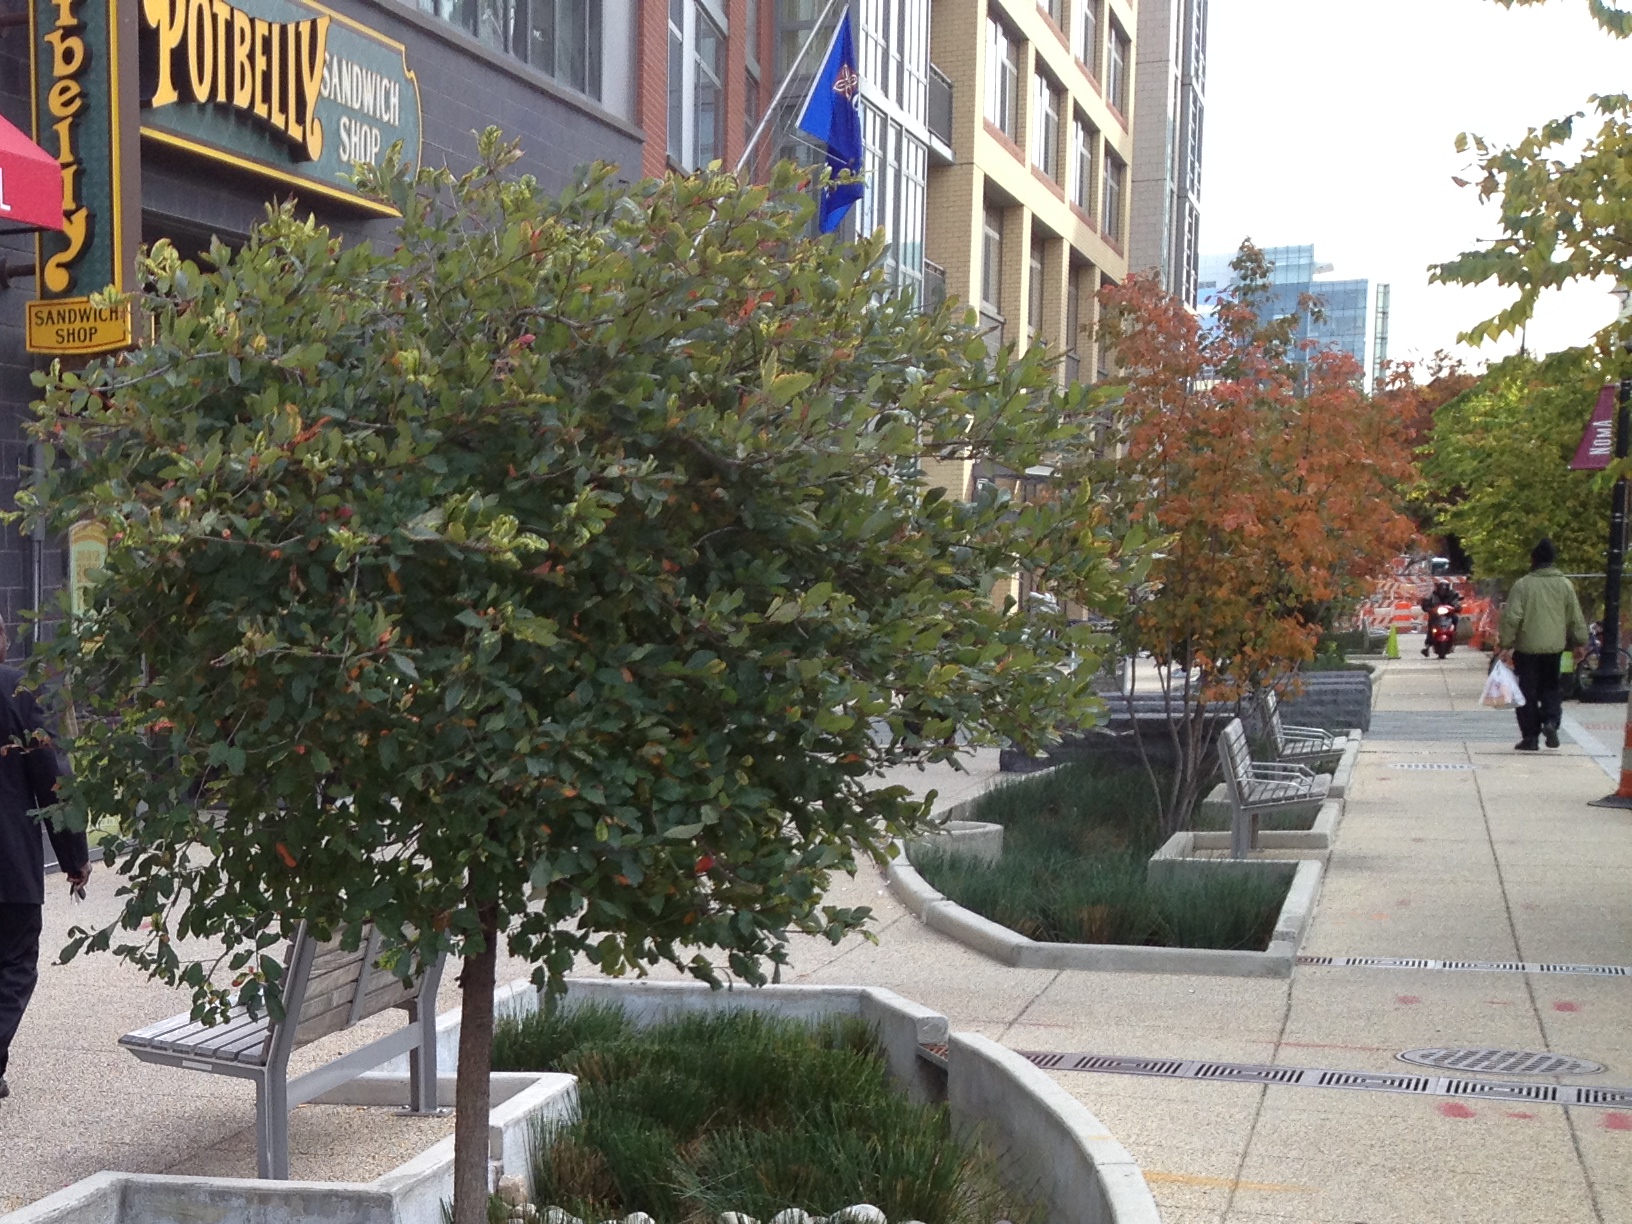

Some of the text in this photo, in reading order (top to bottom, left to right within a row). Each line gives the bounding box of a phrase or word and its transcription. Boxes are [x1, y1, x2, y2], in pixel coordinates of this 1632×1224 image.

[142, 0, 331, 162] POTBELLY
[320, 50, 400, 127] SANDWICH
[339, 115, 382, 165] SHOP
[34, 306, 119, 327] SANDWICH
[55, 326, 98, 345] SHOP
